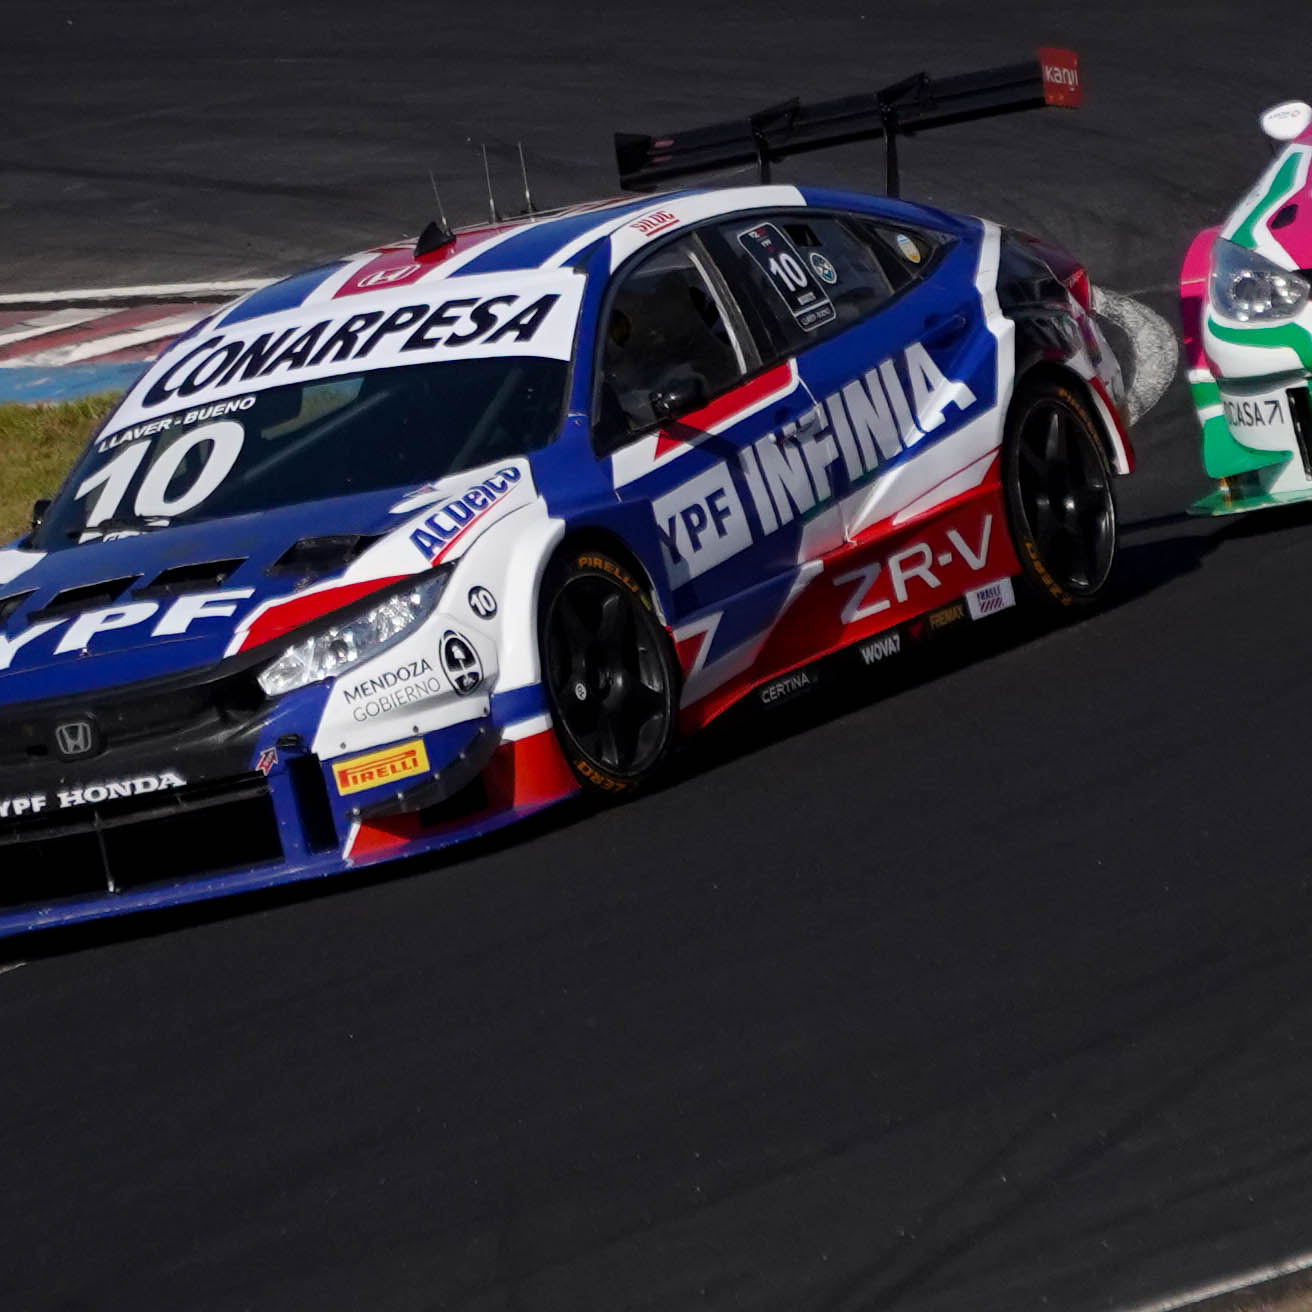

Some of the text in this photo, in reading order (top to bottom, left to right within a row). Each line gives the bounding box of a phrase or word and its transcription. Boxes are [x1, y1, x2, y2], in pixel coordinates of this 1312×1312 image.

[769, 252, 809, 293] 10
[141, 293, 563, 409] CONARPESA
[738, 341, 979, 537] INFINIA
[73, 420, 246, 544] 10
[408, 466, 522, 563] ACDelco
[655, 488, 734, 565] YPF
[833, 514, 993, 626] ZR-V
[470, 588, 496, 617] 10
[342, 657, 434, 705] MENDOZA
[352, 676, 442, 724] GOBIERNO
[760, 672, 811, 705] CERTINA
[55, 771, 188, 809] HONDA
[337, 748, 420, 789] PIRELLI
